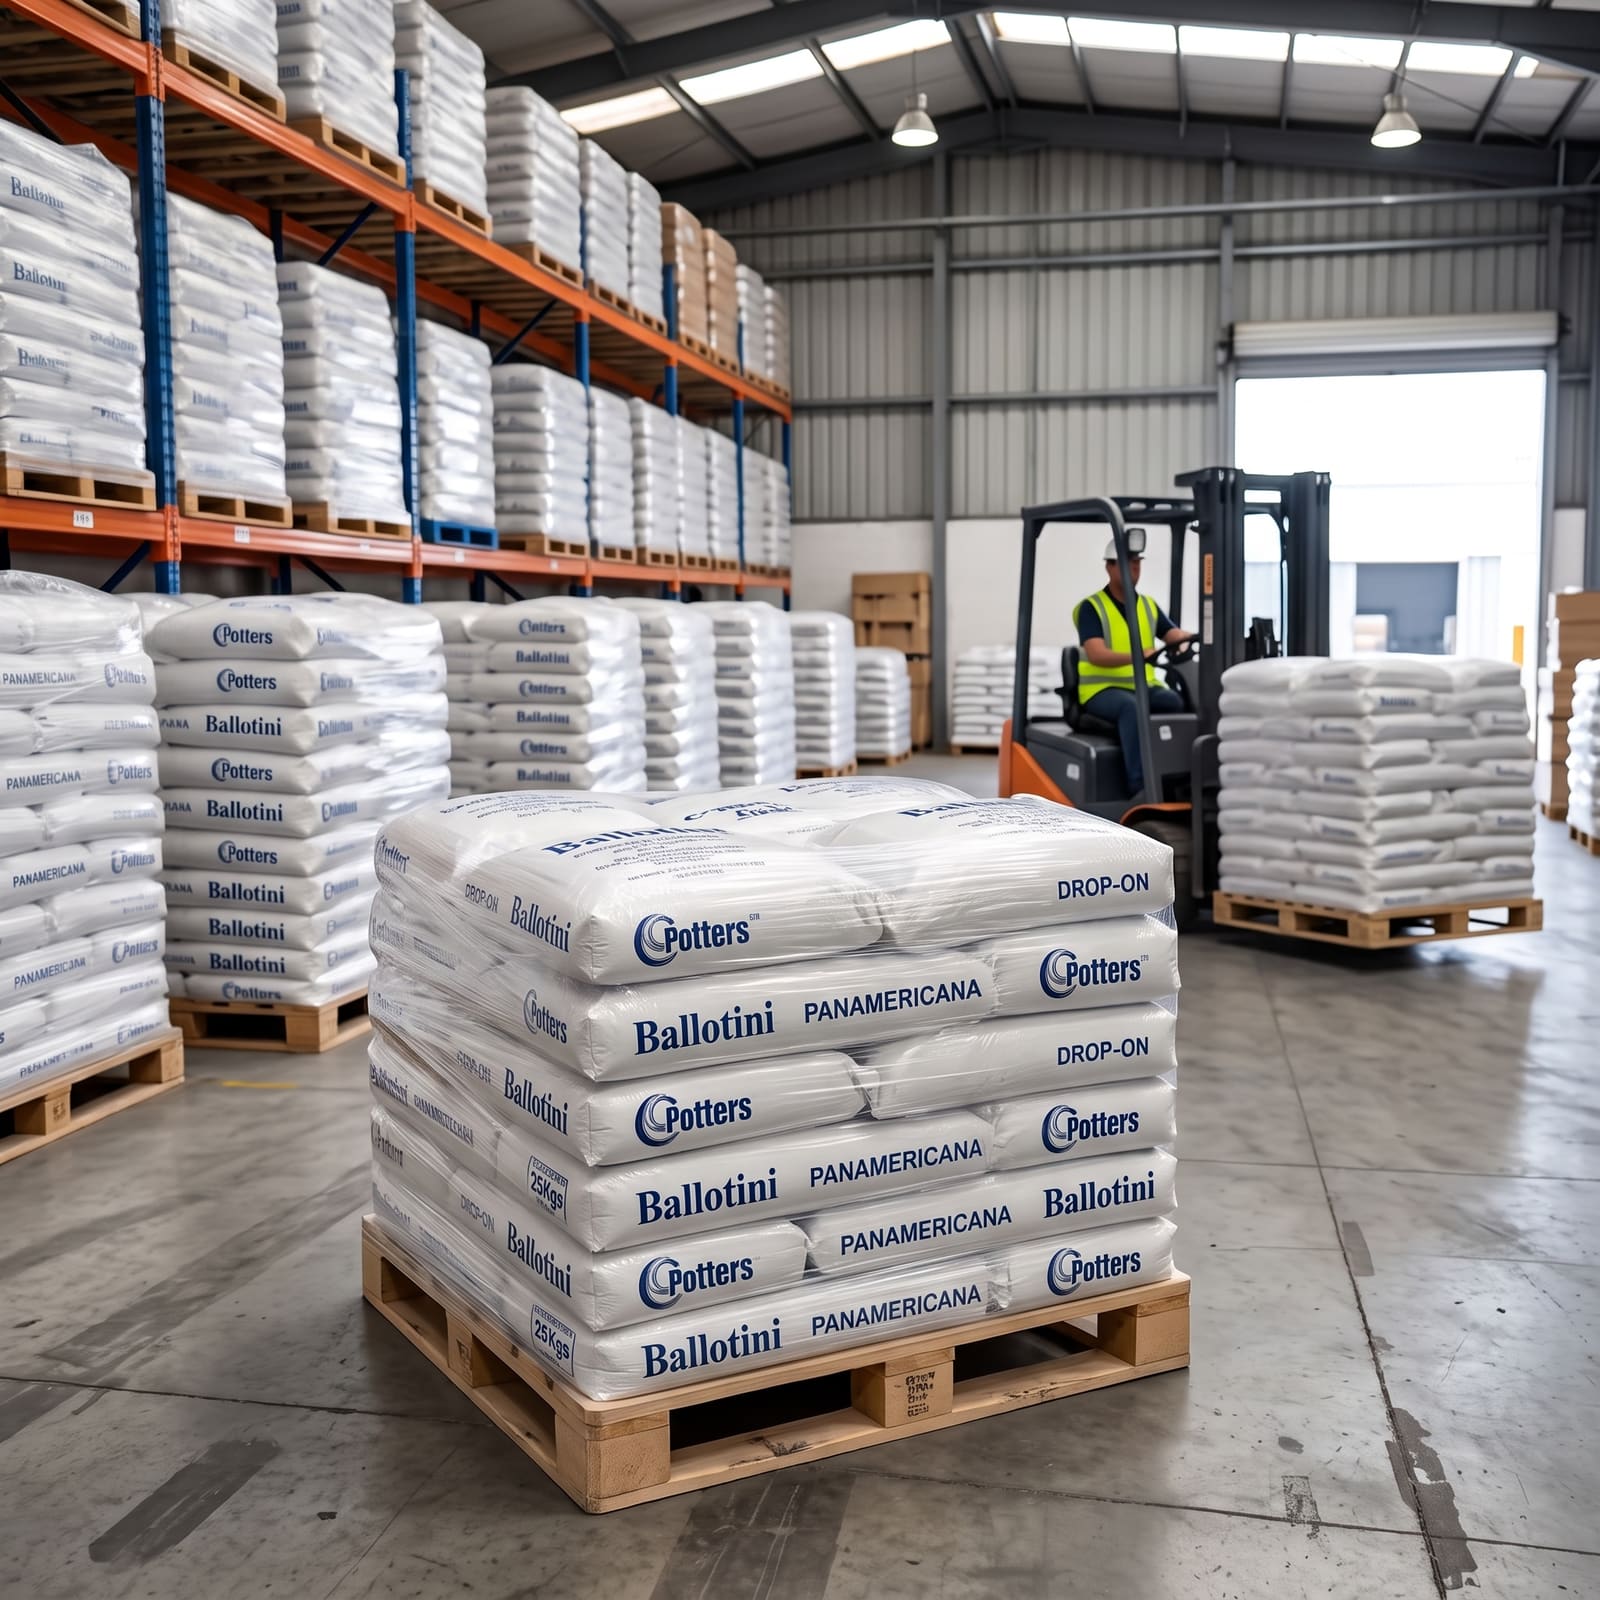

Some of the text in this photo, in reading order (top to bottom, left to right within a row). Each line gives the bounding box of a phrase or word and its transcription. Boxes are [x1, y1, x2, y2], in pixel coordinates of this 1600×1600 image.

[222, 625, 273, 645] Potters
[228, 672, 277, 691] Potters
[206, 714, 282, 737] Ballotini
[222, 762, 273, 782] Potters
[207, 799, 283, 822] Ballotini
[228, 845, 278, 864] Potters
[13, 862, 87, 888] PANAMERICANA
[1058, 872, 1149, 900] DROP-ON
[208, 881, 285, 904] Ballotini
[208, 918, 285, 941] Ballotini
[510, 895, 572, 953] Ballotini
[663, 919, 750, 954] Potters
[209, 953, 286, 975] Ballotini
[1066, 957, 1141, 987] Potters
[530, 1001, 568, 1044] Potters
[633, 978, 983, 1056] Ballotini PANAMERICANA
[1057, 1036, 1149, 1066] DROP-ON
[503, 1066, 569, 1137] Ballotini
[665, 1096, 752, 1134] Potters
[1066, 1111, 1140, 1143] Potters
[530, 1170, 564, 1211] 25Kgs
[635, 1138, 983, 1226] Ballotini PANAMERICANA
[840, 1170, 1156, 1256] PANAMERICANA Ballotini
[507, 1220, 573, 1299] Ballotini
[1071, 1251, 1142, 1285] Potters
[667, 1257, 755, 1297] Potters
[534, 1318, 570, 1361] 25Kgs
[640, 1317, 784, 1379] Ballotini
[811, 1283, 982, 1337] PANAMERICANA
